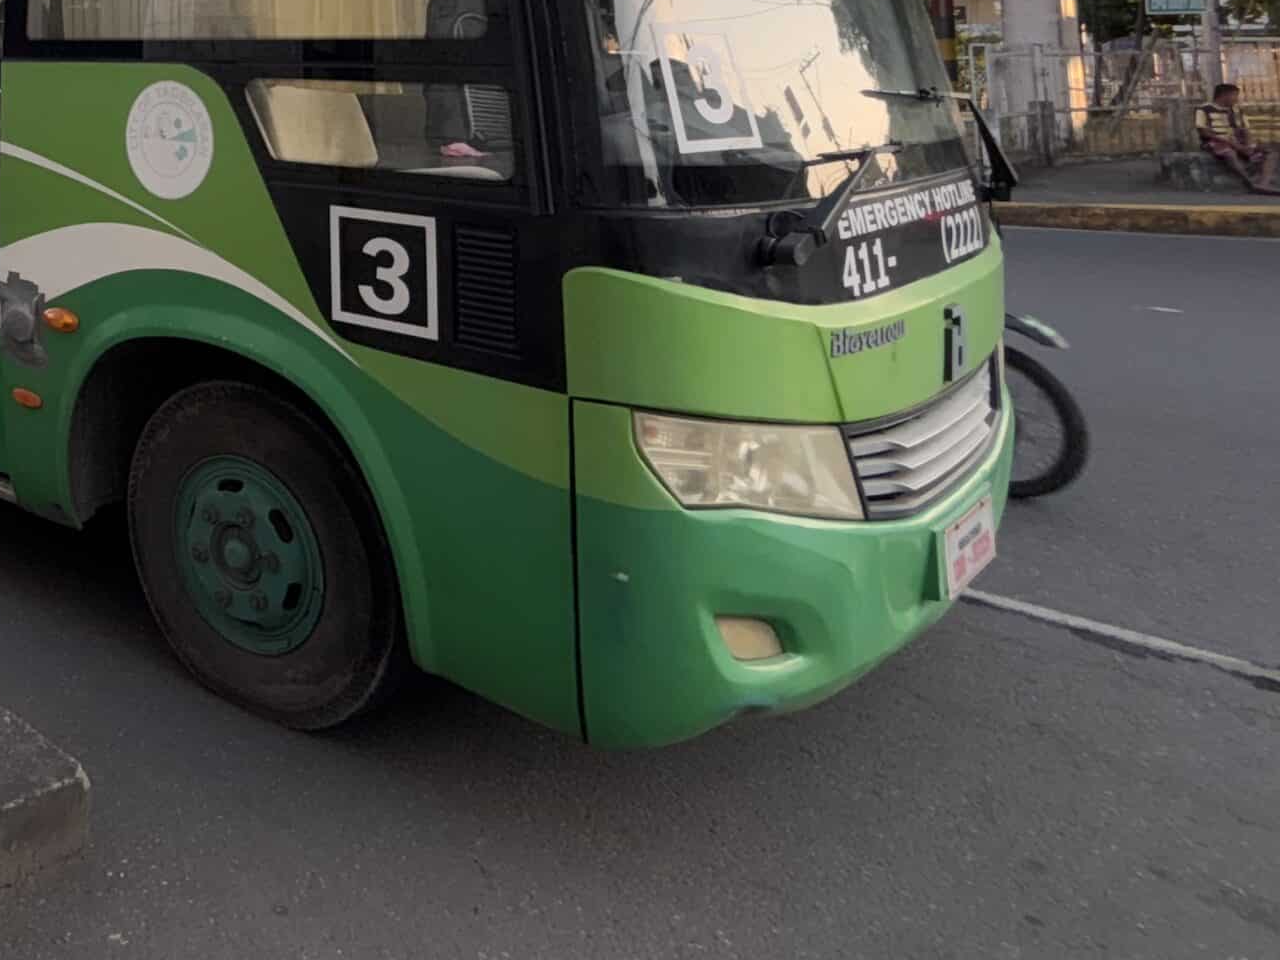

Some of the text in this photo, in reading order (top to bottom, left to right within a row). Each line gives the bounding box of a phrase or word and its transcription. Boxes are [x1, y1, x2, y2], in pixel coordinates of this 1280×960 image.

[688, 45, 734, 124] 3
[837, 179, 977, 239] EMERGENCY HOTLINE
[358, 236, 411, 315] 3
[843, 238, 897, 297] 411-
